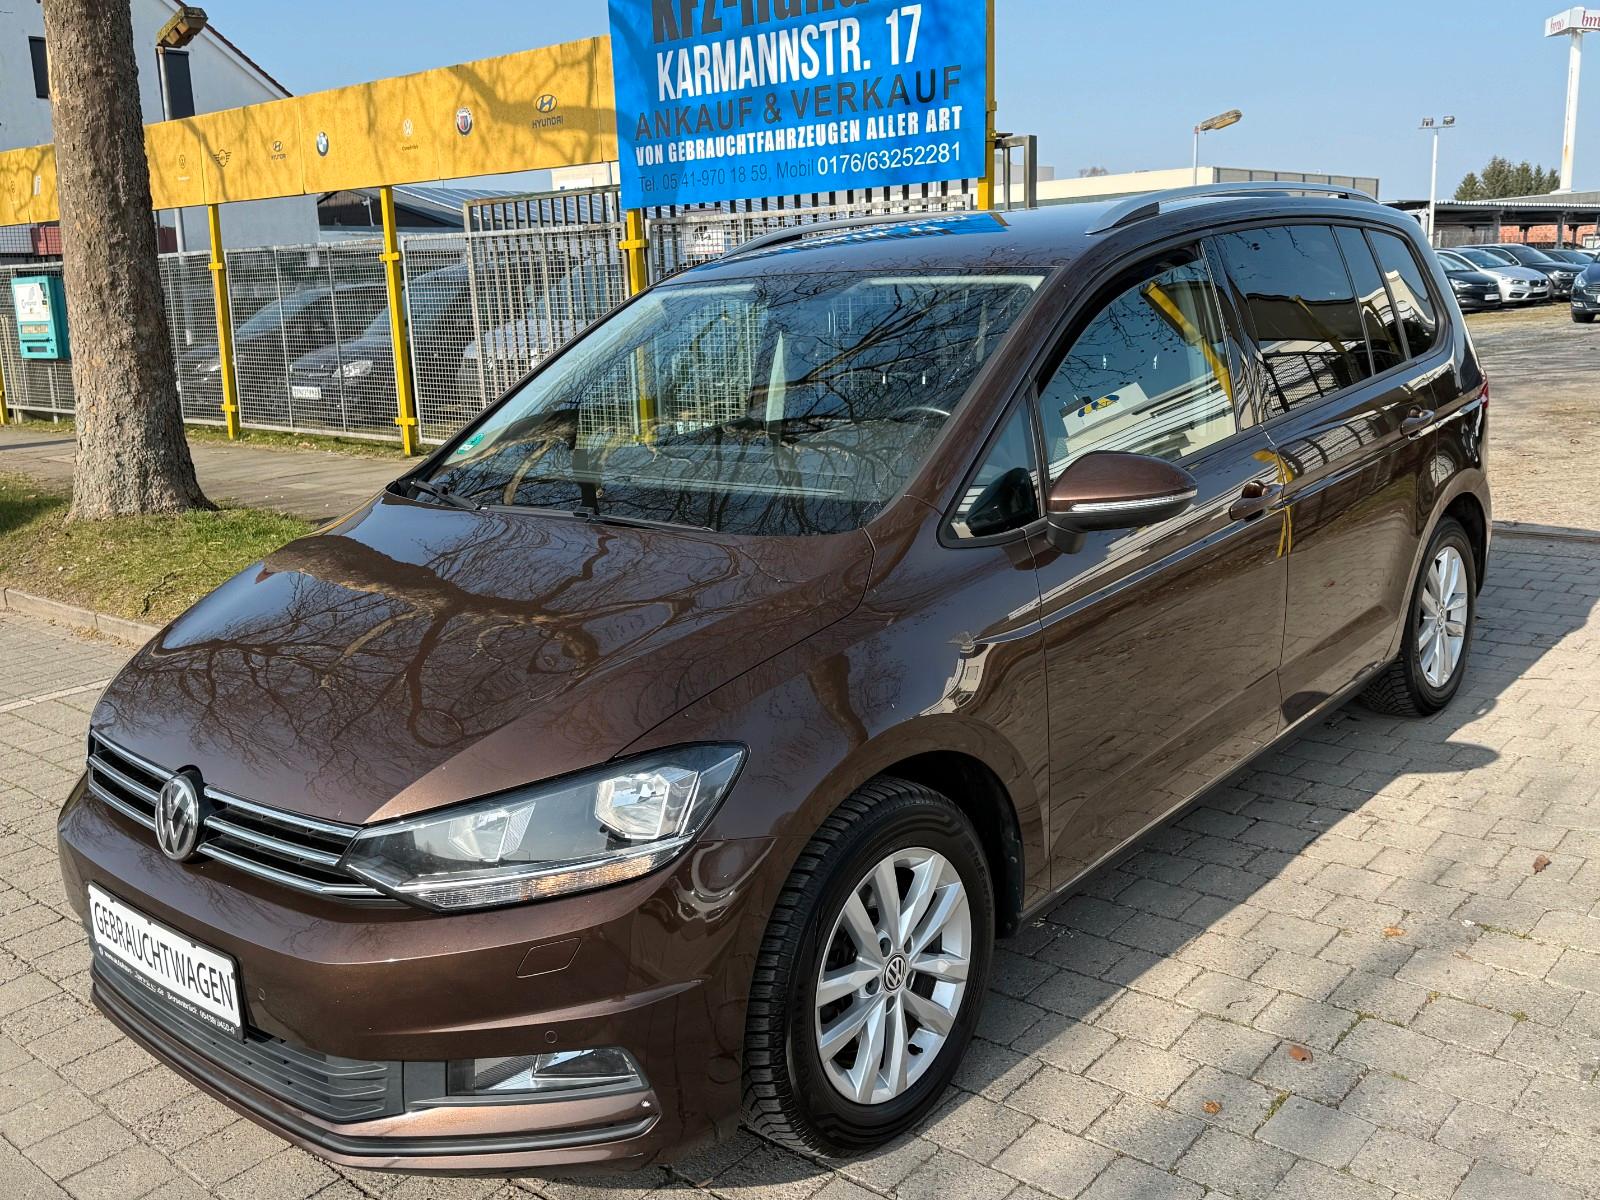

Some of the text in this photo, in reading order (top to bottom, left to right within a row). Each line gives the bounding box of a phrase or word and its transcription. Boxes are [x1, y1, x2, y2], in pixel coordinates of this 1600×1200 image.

[656, 17, 871, 102] KARMANNSTR.
[885, 3, 922, 66] 17
[531, 115, 565, 130] HYUNDAI
[635, 64, 962, 141] ANKAUF & VERKAUF
[635, 105, 963, 167] VON GEBRAUCHTFAHRZEUGEN ALLER ART
[638, 140, 961, 193] Tel. 05 41-970 18 59, Mobil 0176/63252281
[94, 901, 235, 1012] GEBRAUCHTWAGEN
